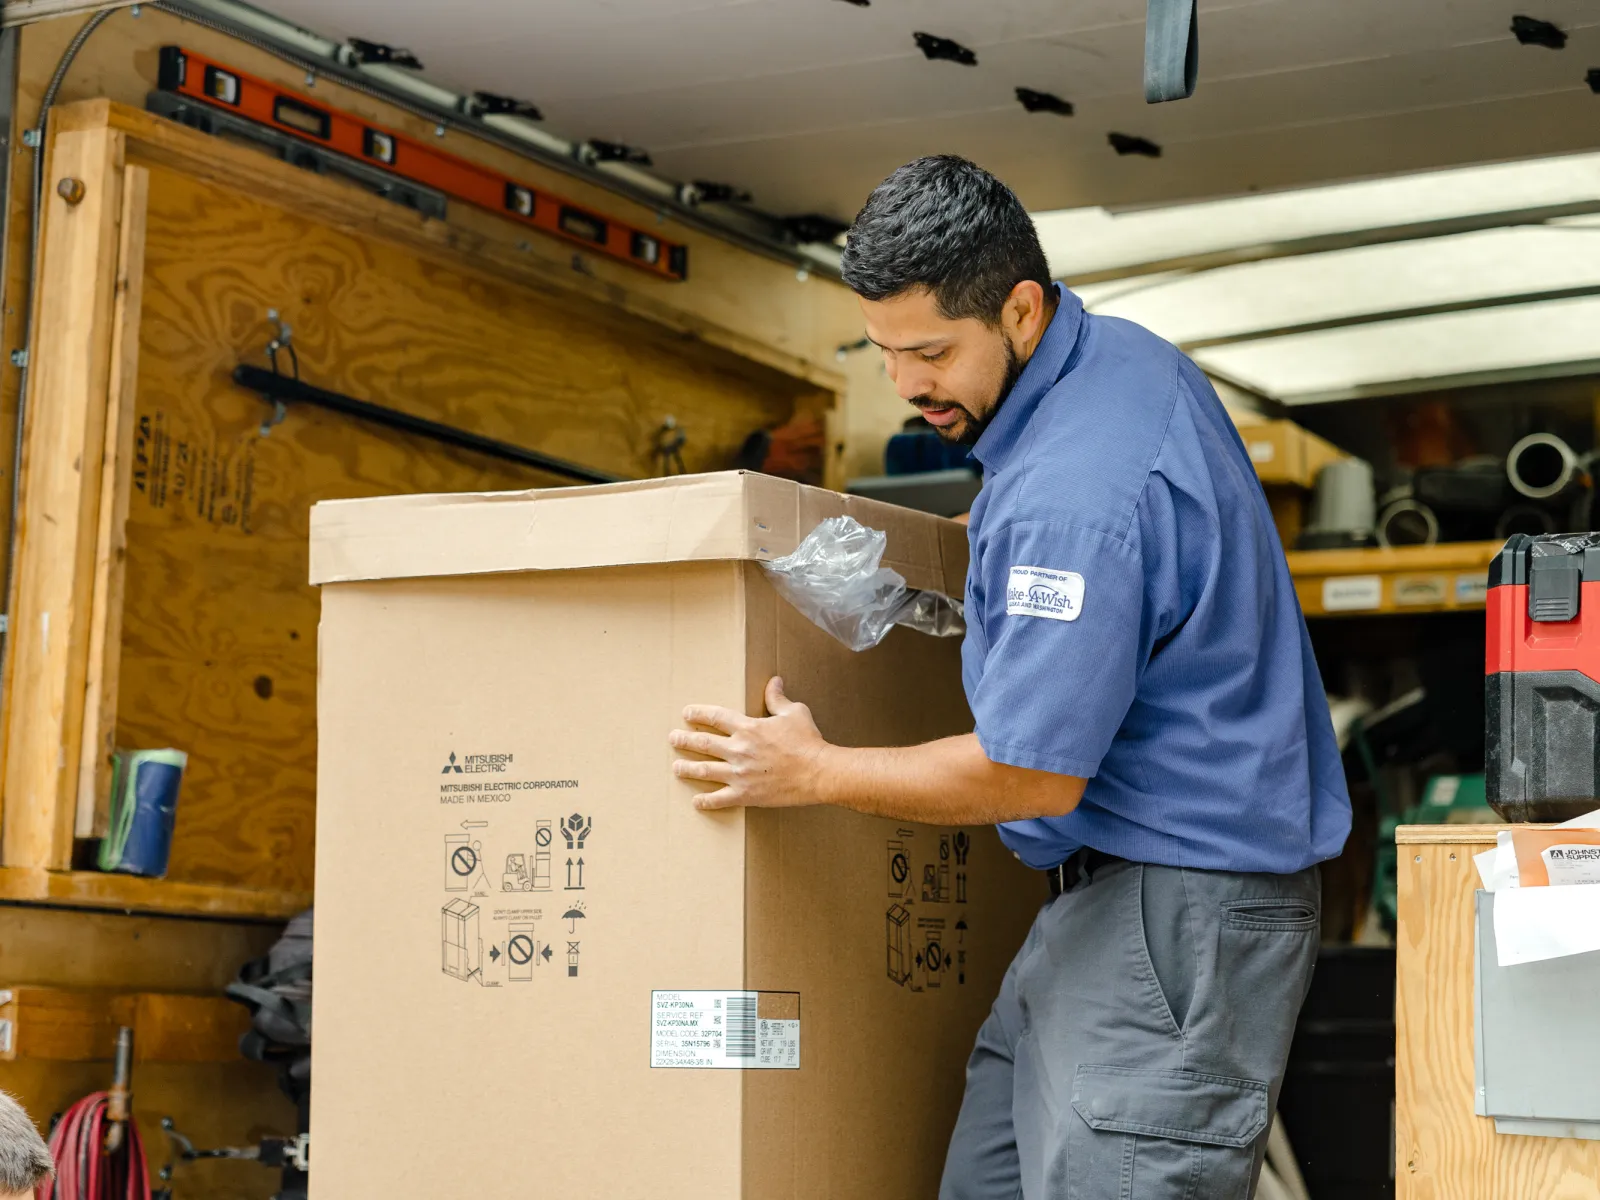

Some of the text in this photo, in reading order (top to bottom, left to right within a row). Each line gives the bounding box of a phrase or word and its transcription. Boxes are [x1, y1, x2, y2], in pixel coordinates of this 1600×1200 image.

[1030, 570, 1058, 580] PARTNER
[1032, 603, 1064, 614] WASHINGTON
[464, 754, 513, 764] MITSUBISHI
[464, 764, 507, 774] ELECTRIC
[440, 780, 579, 793] MITSUBISHI ELECTRIC CORPORATION
[440, 793, 512, 804] MADE IN MEXICO
[656, 993, 682, 1001] MODEL
[656, 1001, 694, 1009] SVZ-KP30NA
